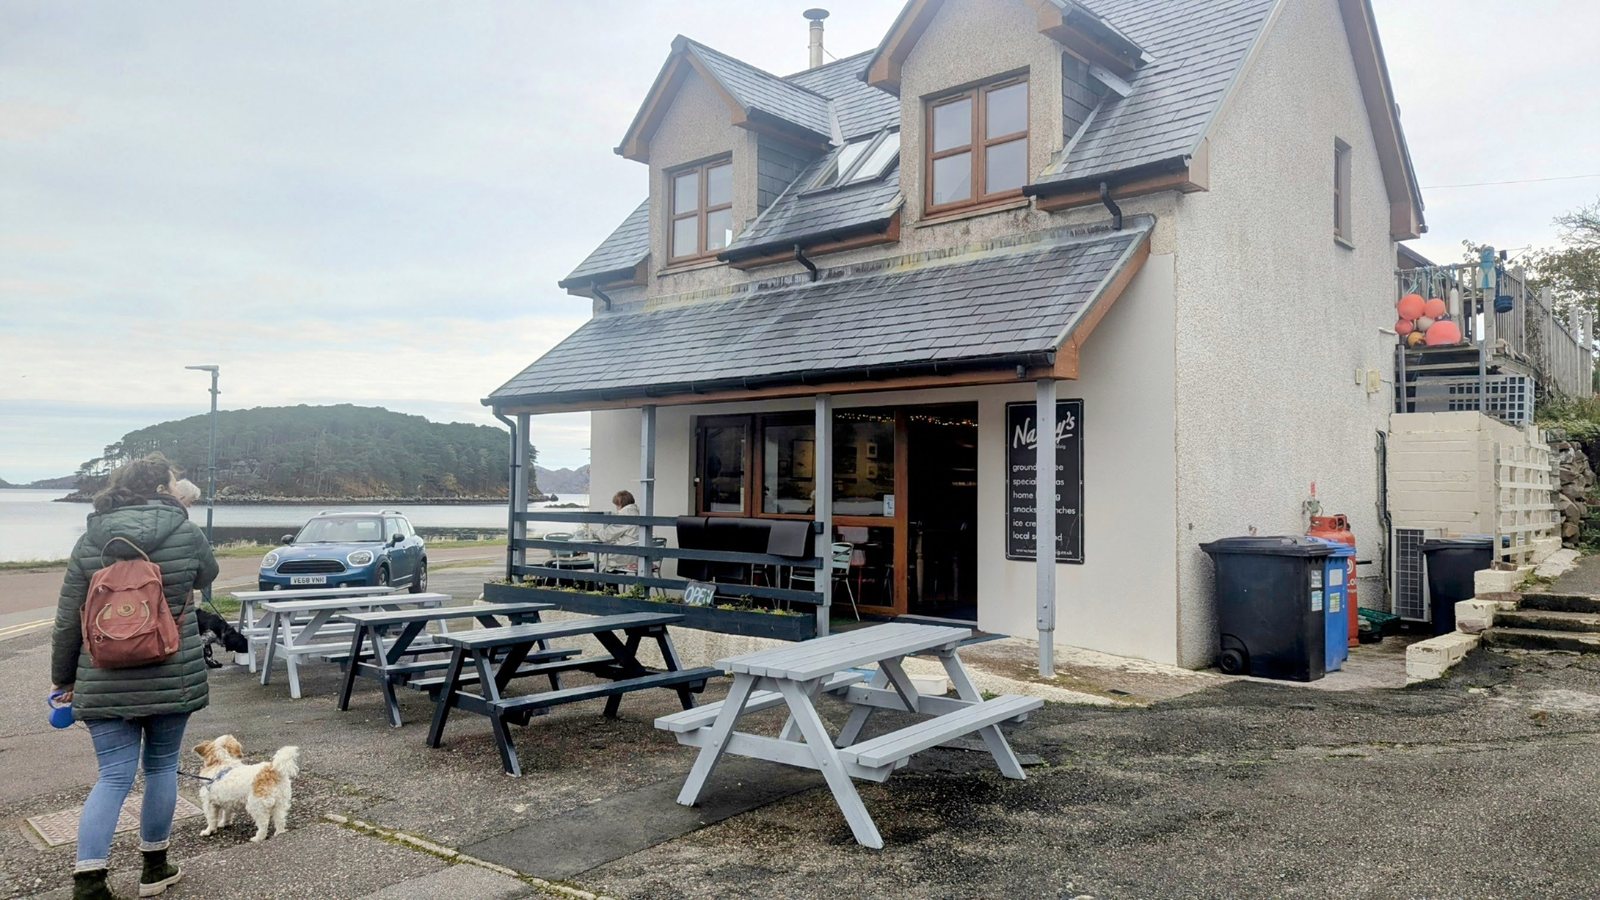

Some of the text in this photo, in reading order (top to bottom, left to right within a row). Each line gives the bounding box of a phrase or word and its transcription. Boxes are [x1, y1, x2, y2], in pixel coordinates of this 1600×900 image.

[1013, 411, 1075, 449] Nay's
[1013, 490, 1034, 499] home
[1013, 519, 1024, 527] ice
[1013, 531, 1030, 540] local
[684, 586, 714, 605] OPEN
